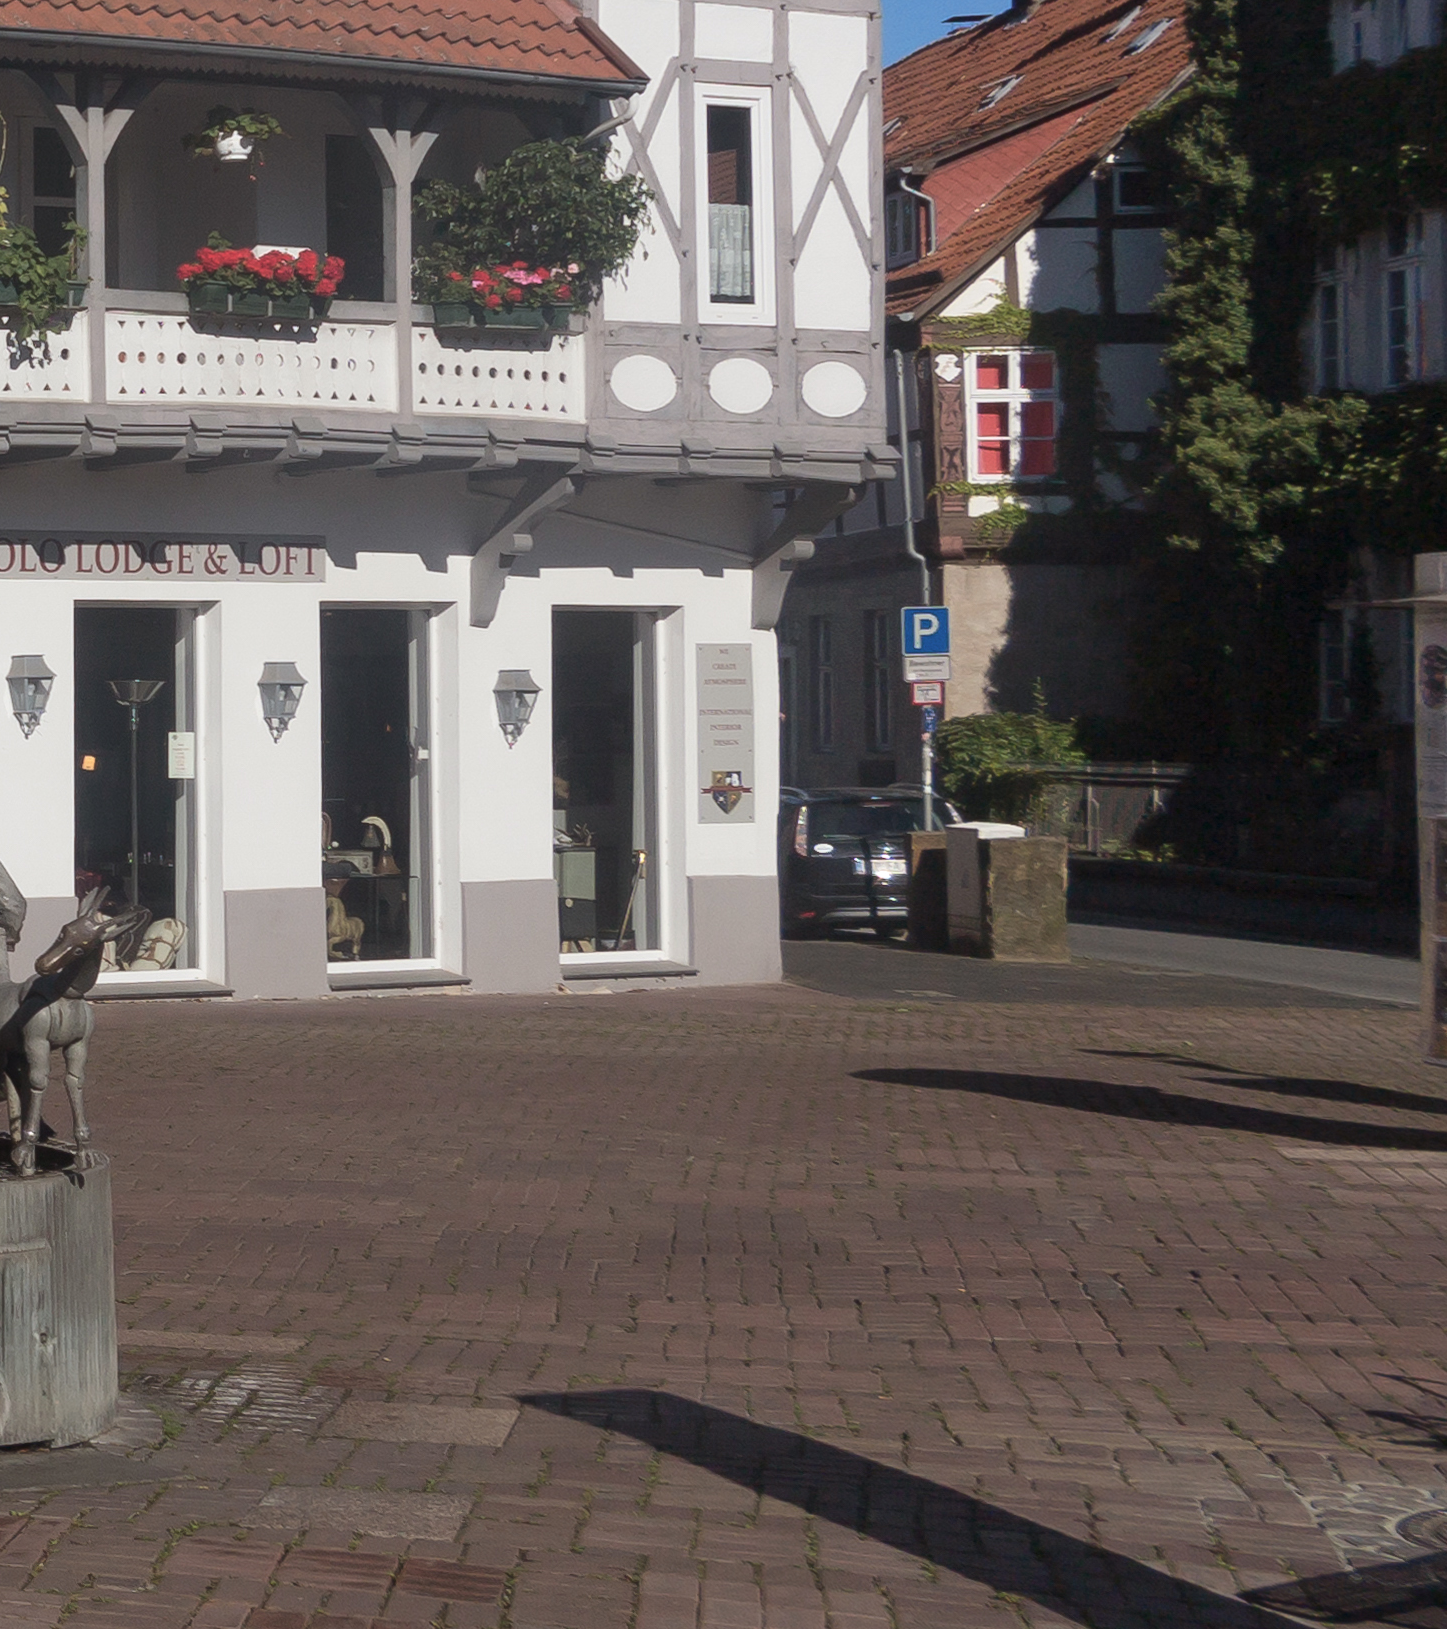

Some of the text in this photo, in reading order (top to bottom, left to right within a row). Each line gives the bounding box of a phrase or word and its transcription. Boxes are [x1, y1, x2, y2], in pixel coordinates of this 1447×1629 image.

[75, 539, 195, 575] LODGE
[202, 541, 229, 575] &
[239, 541, 318, 576] LOFT
[913, 613, 940, 649] P
